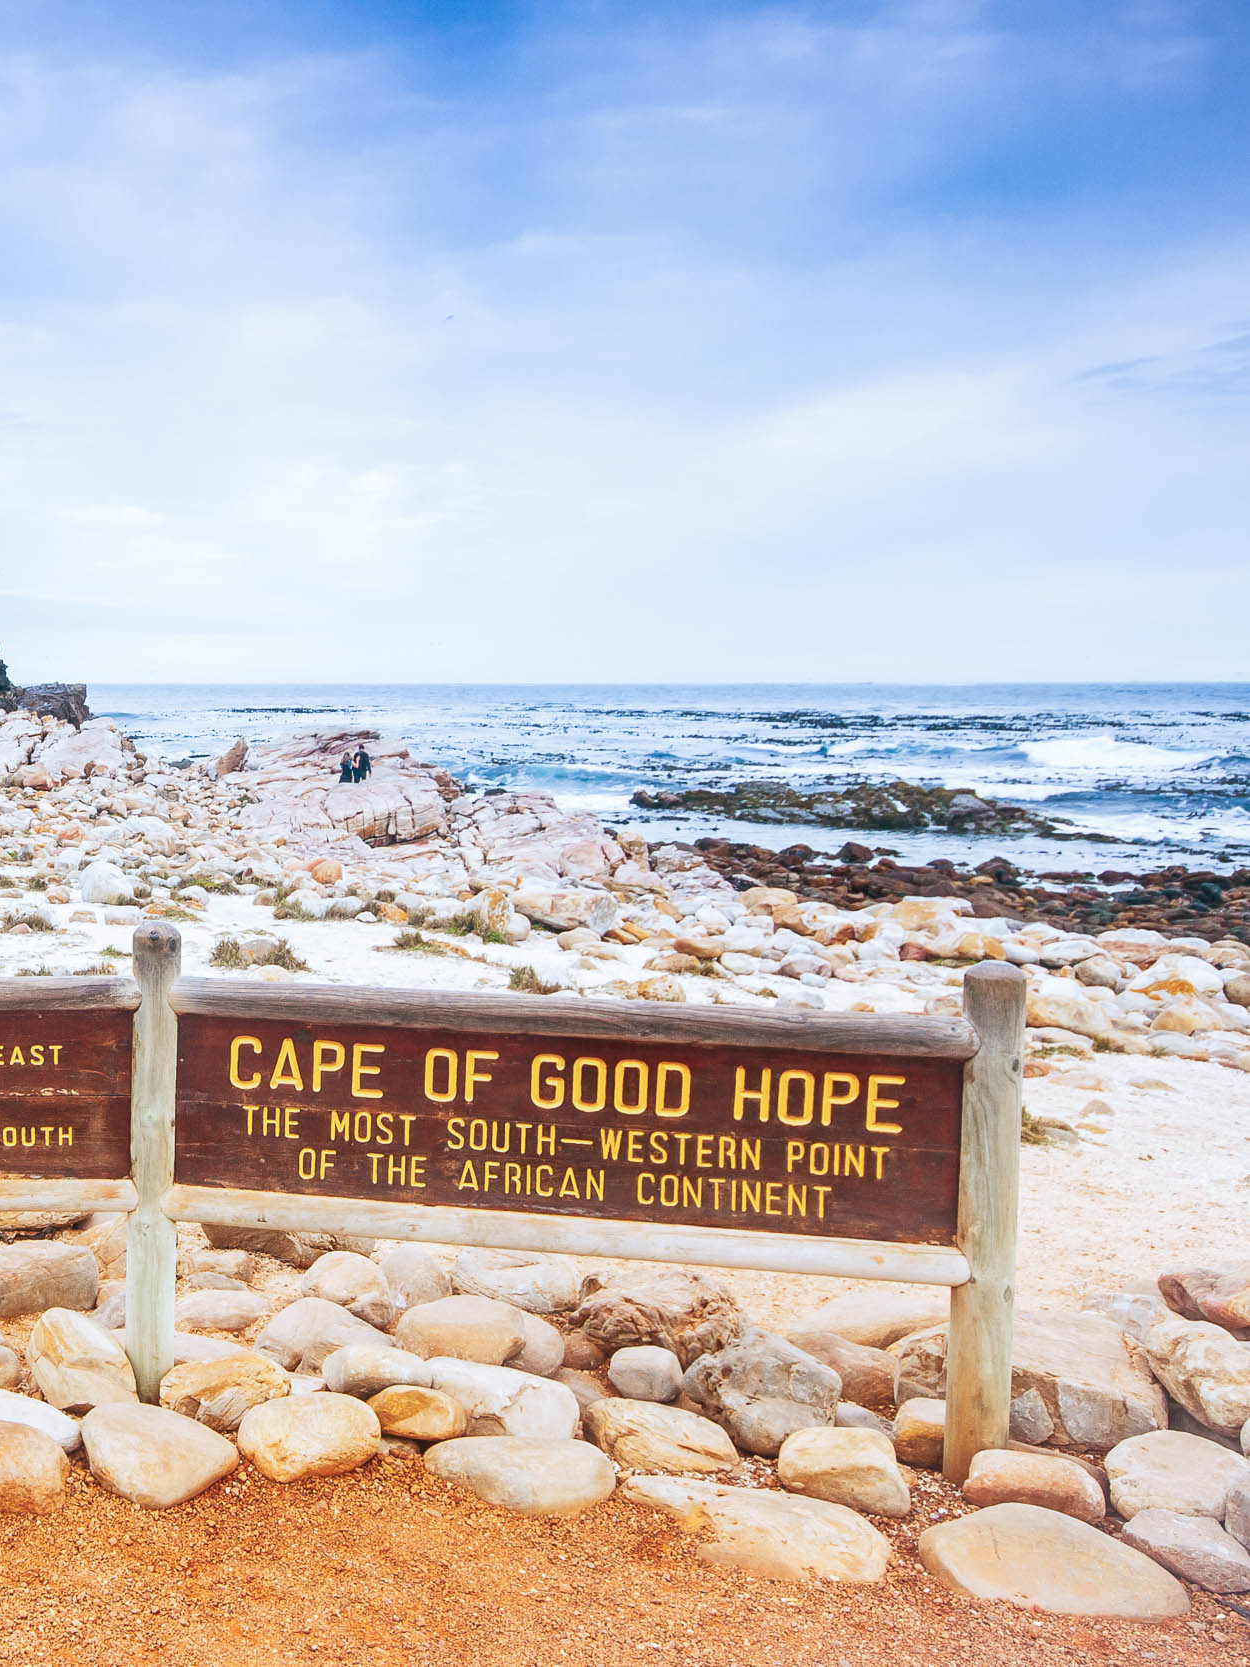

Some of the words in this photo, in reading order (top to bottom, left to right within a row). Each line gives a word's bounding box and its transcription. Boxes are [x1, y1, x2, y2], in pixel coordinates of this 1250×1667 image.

[229, 1035, 386, 1099] CAPE
[424, 1047, 500, 1105] OF
[530, 1054, 692, 1118] GOOD
[733, 1067, 906, 1134] HOPE
[242, 1104, 301, 1139] THE
[330, 1109, 417, 1147] MOST
[786, 1140, 891, 1180] POINT
[298, 1147, 337, 1180] OF
[366, 1152, 428, 1188] THE
[456, 1159, 605, 1202] AFRICAN
[636, 1172, 833, 1220] CONTINENT
